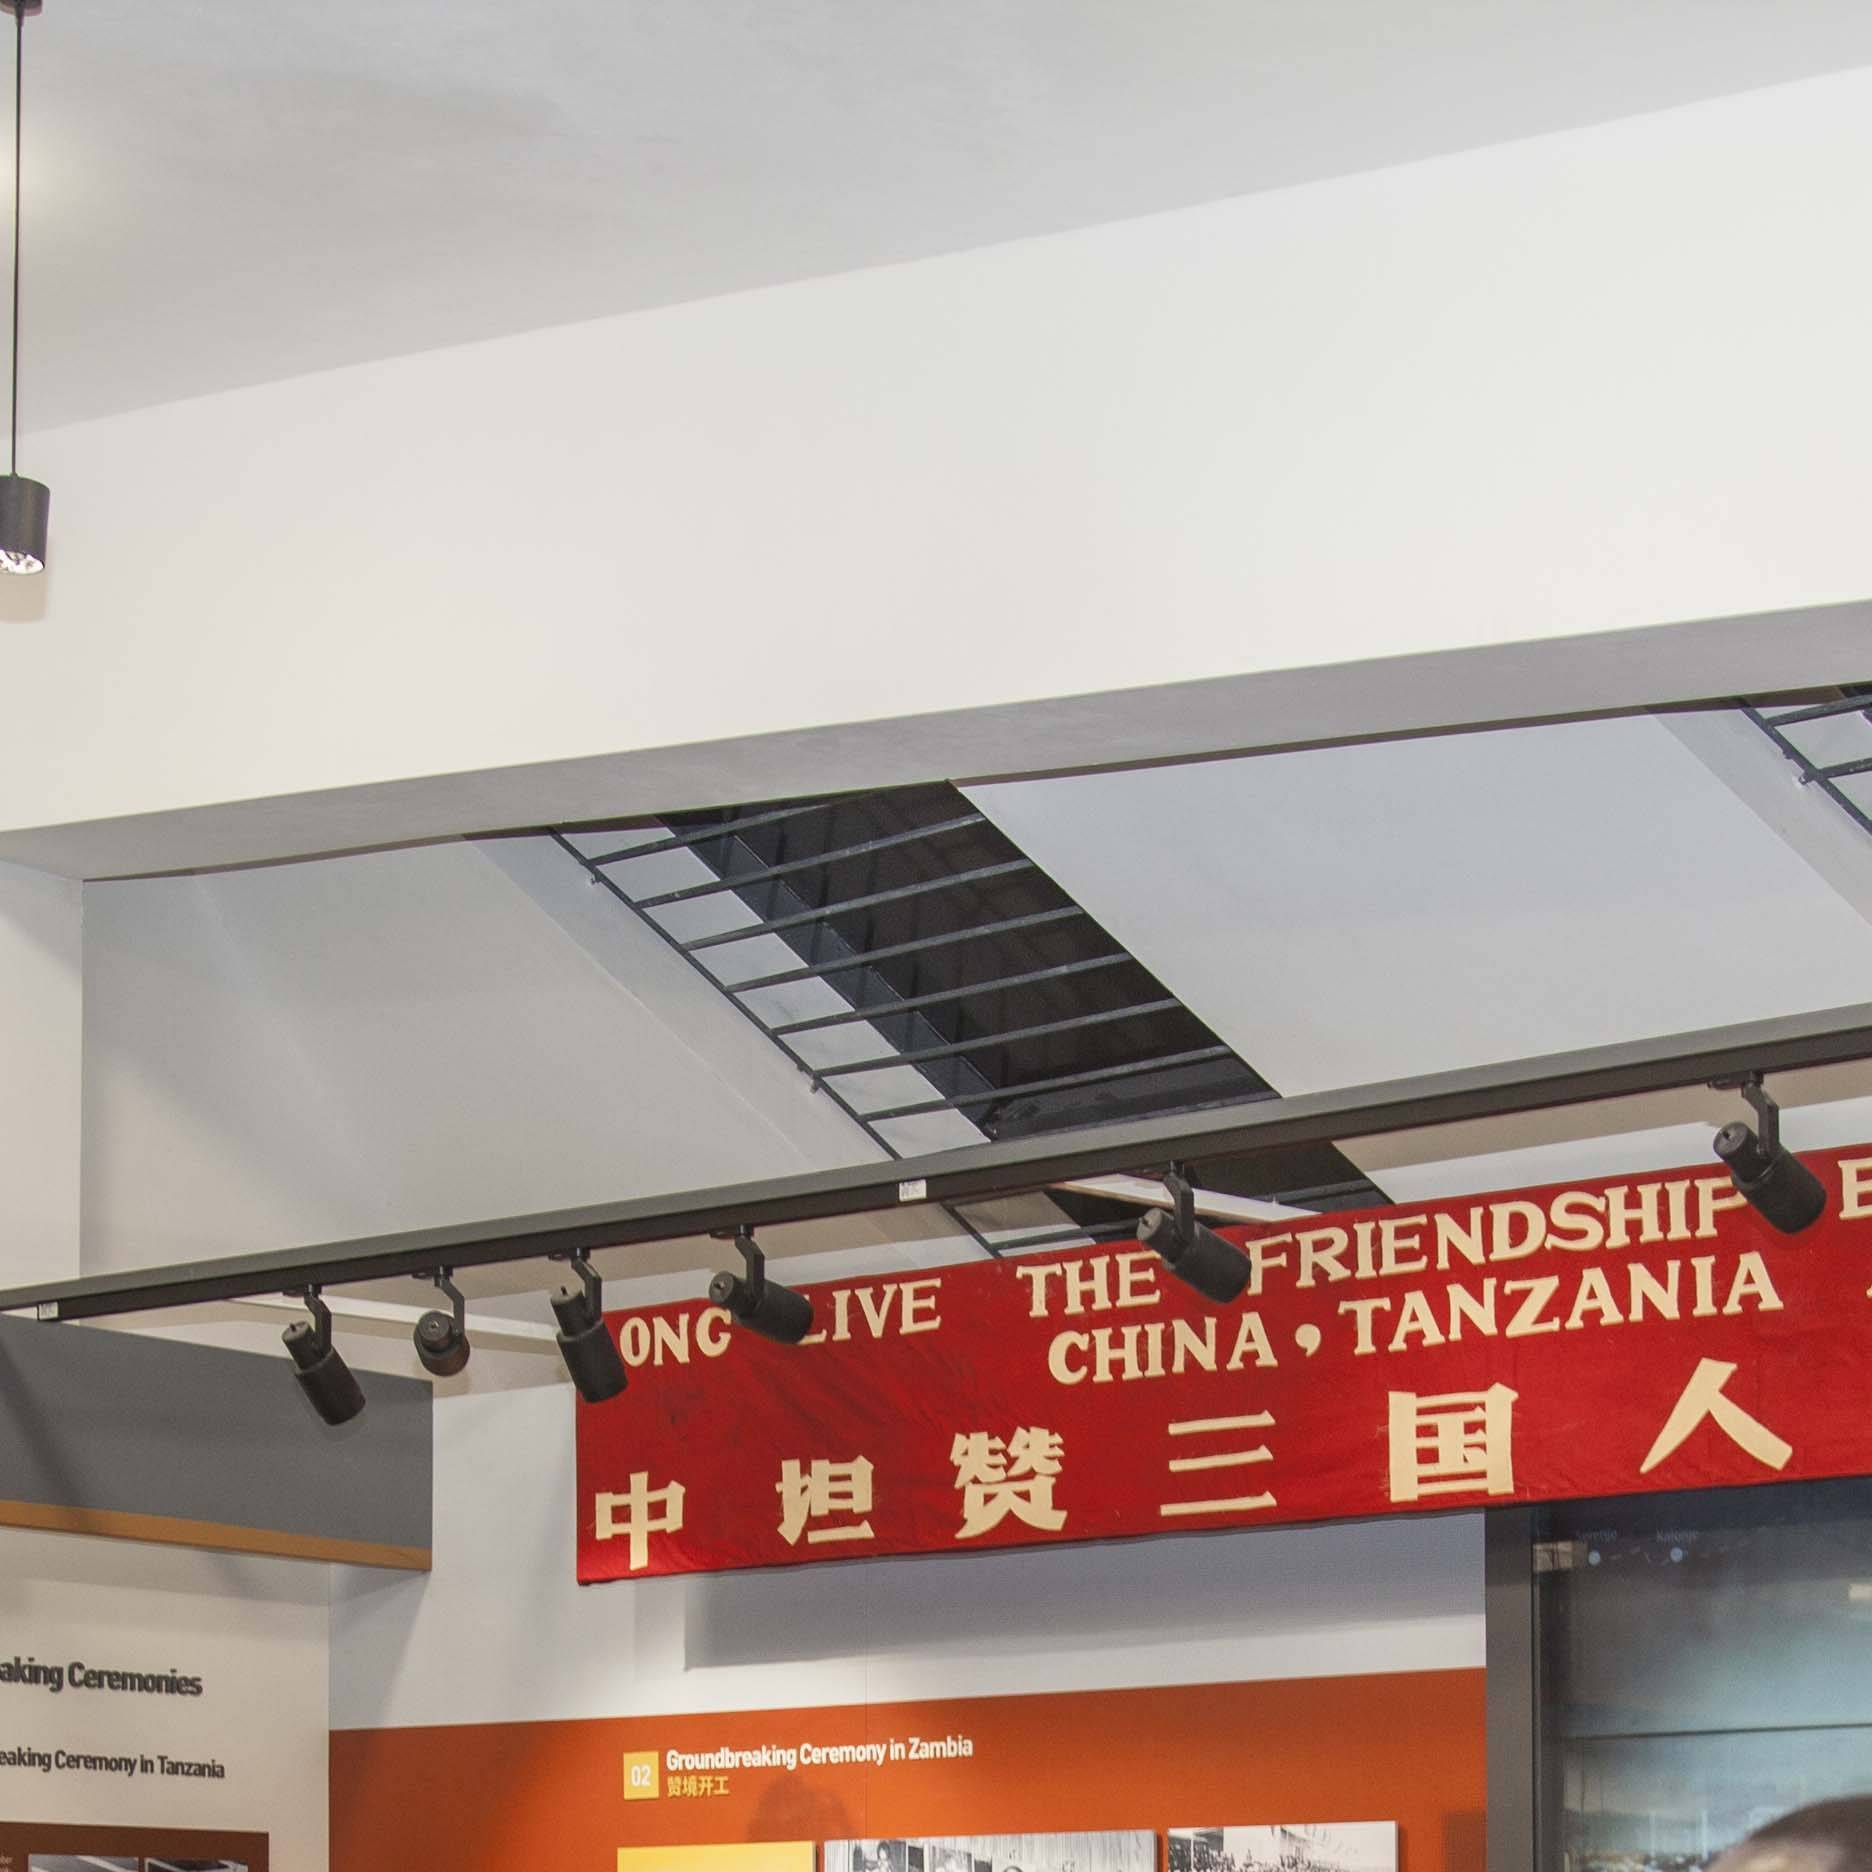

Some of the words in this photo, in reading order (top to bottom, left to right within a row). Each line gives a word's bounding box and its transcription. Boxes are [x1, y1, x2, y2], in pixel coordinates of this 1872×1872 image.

[620, 1307, 731, 1367] ONG
[1016, 1250, 1161, 1318] THE
[1246, 1177, 1749, 1296] FRIENDSHIP
[1338, 1251, 1784, 1355] TANZANIA
[68, 1661, 203, 1696] Ceremonies
[55, 1751, 136, 1777] Ceremony
[139, 1754, 154, 1774] in
[157, 1756, 225, 1779] Tanzania
[631, 1764, 651, 1786] 02
[667, 1745, 797, 1771] Groundbreaking
[799, 1743, 886, 1767] Ceremony
[889, 1739, 905, 1760] in
[908, 1735, 973, 1760] Zambia
